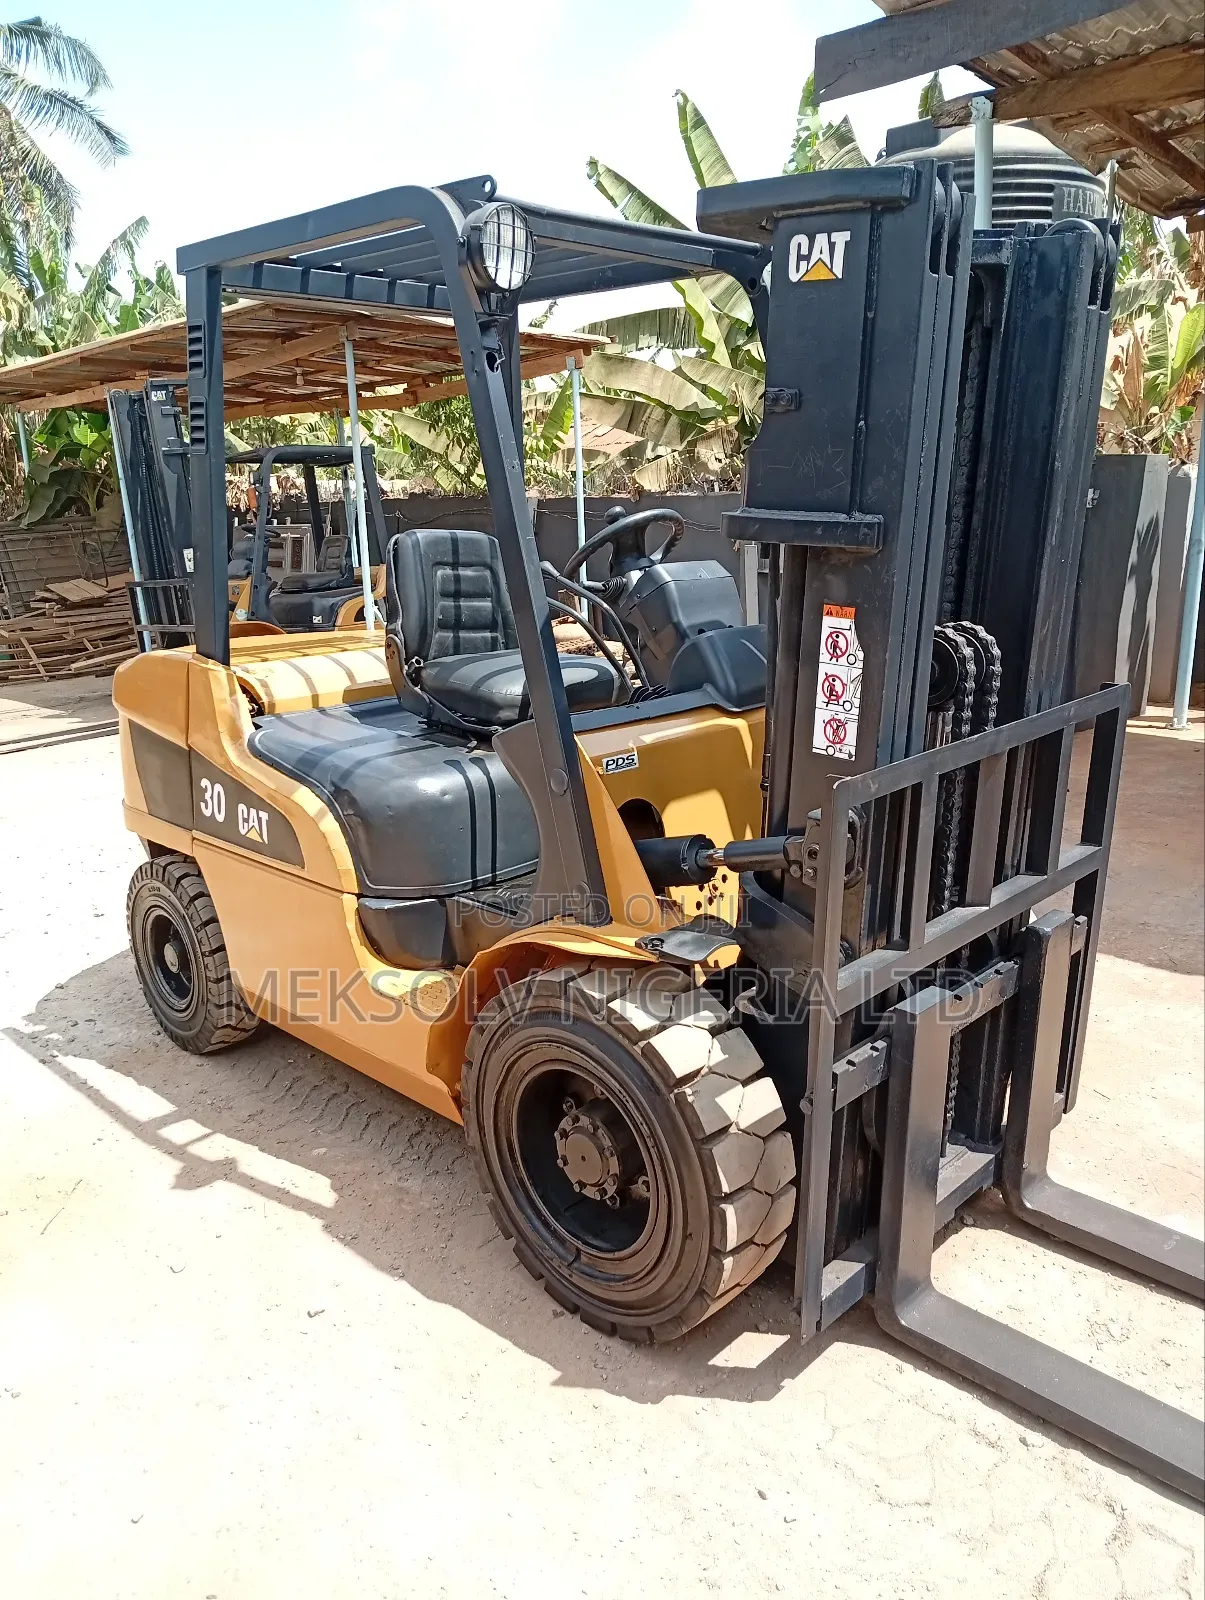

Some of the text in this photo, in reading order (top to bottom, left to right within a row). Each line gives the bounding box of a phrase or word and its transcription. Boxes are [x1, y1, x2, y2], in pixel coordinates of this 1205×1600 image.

[788, 230, 851, 283] CAT
[151, 390, 167, 402] CAT
[605, 753, 636, 770] PDS
[200, 777, 269, 844] 30 CAT
